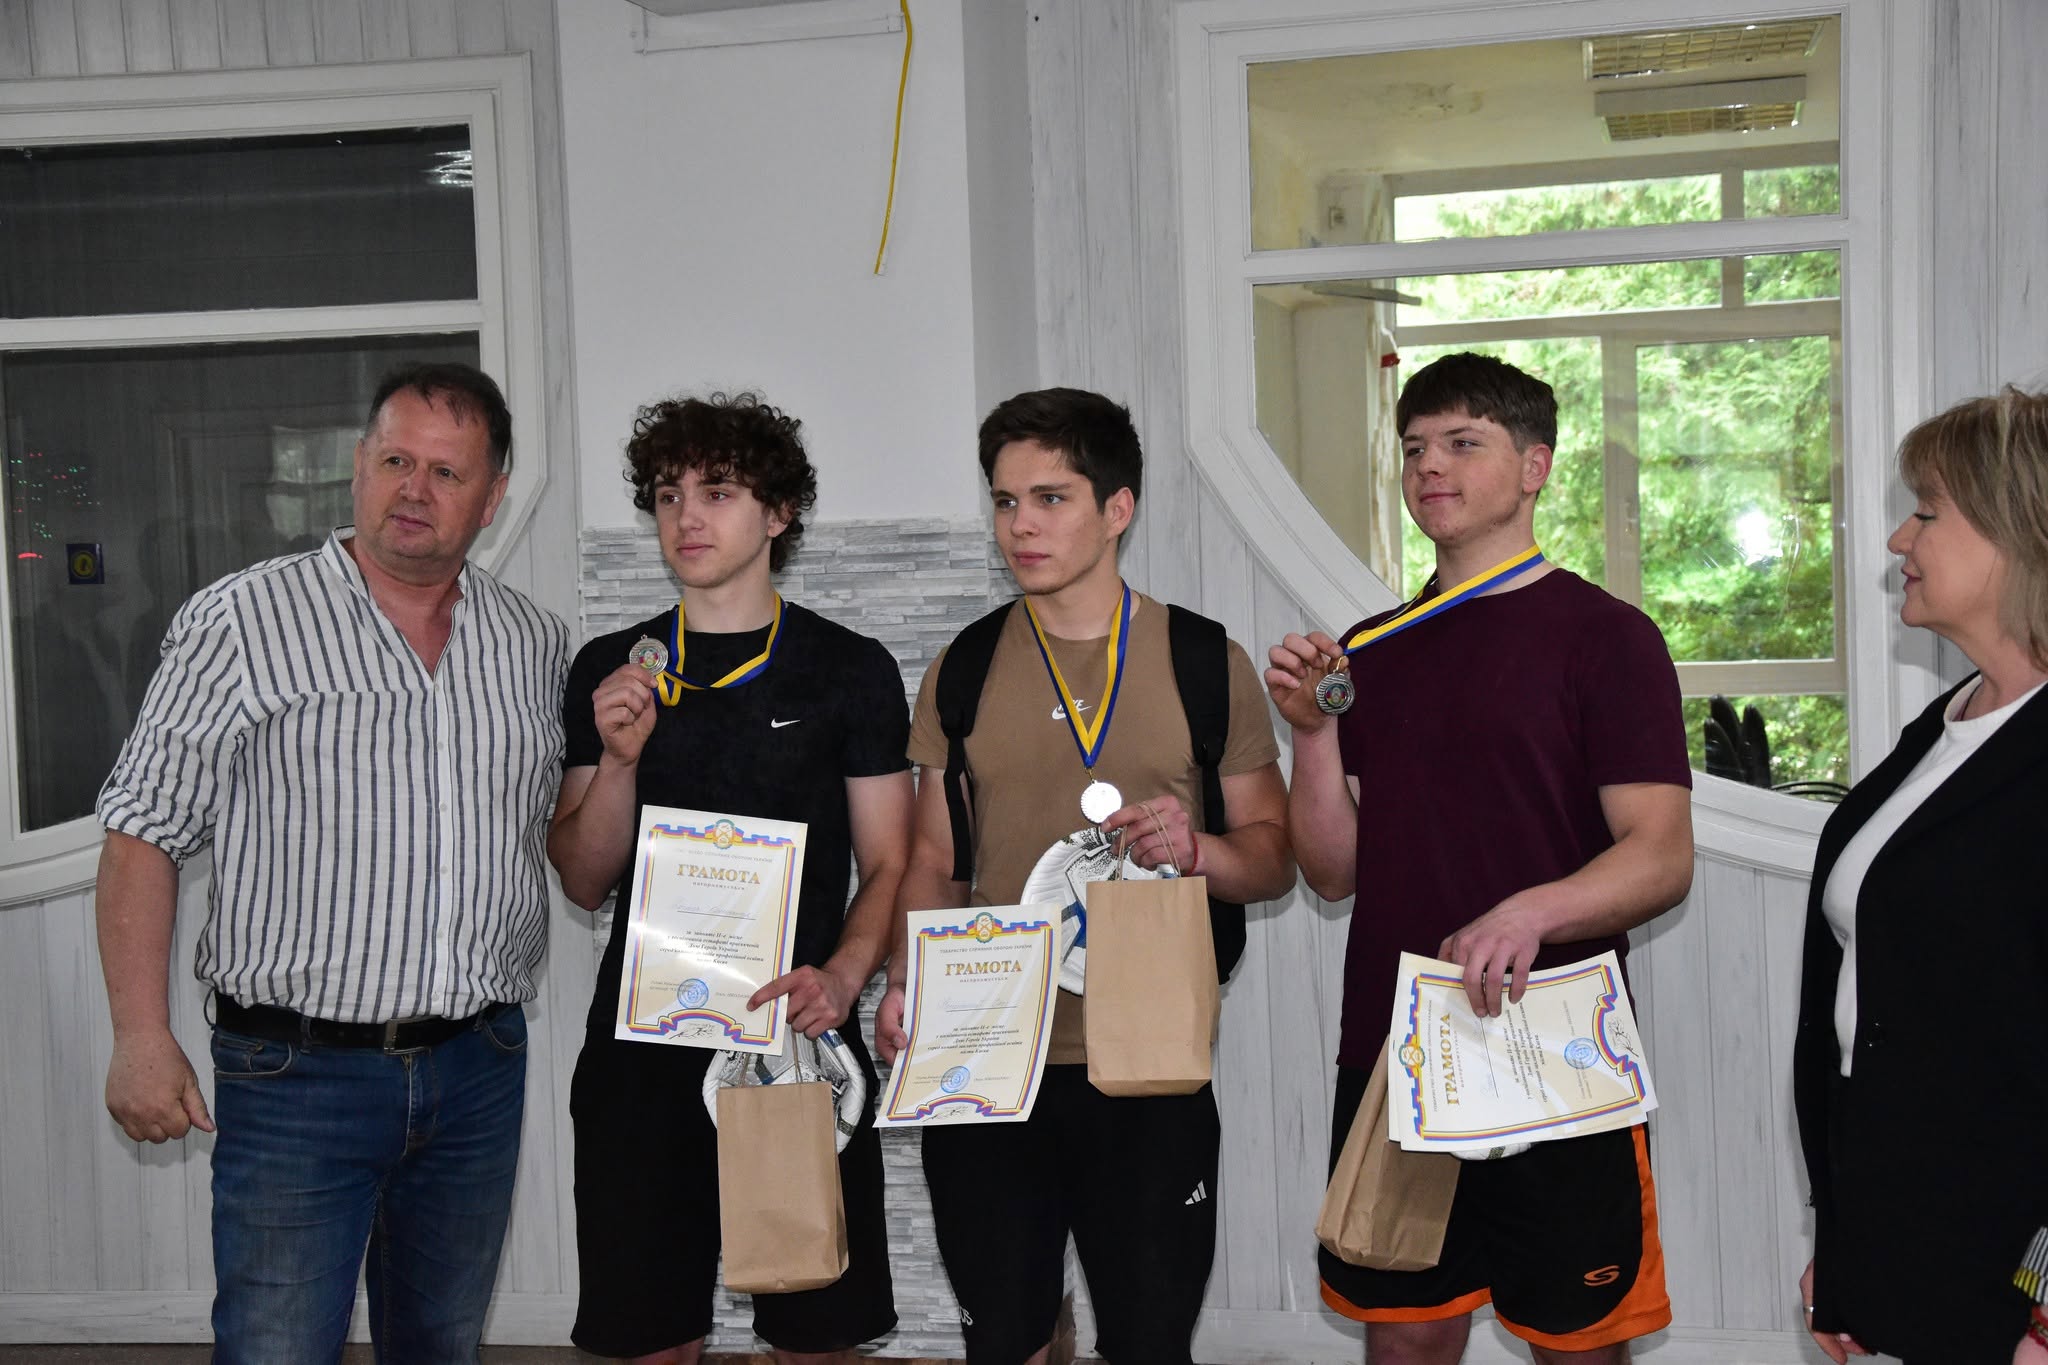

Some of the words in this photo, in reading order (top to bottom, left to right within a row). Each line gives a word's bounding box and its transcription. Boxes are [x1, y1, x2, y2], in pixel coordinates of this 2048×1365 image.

[677, 864, 760, 884] ГРАМОТА
[945, 960, 1023, 976] ГРАМОТА
[1440, 1014, 1460, 1105] ГРАМОТА
